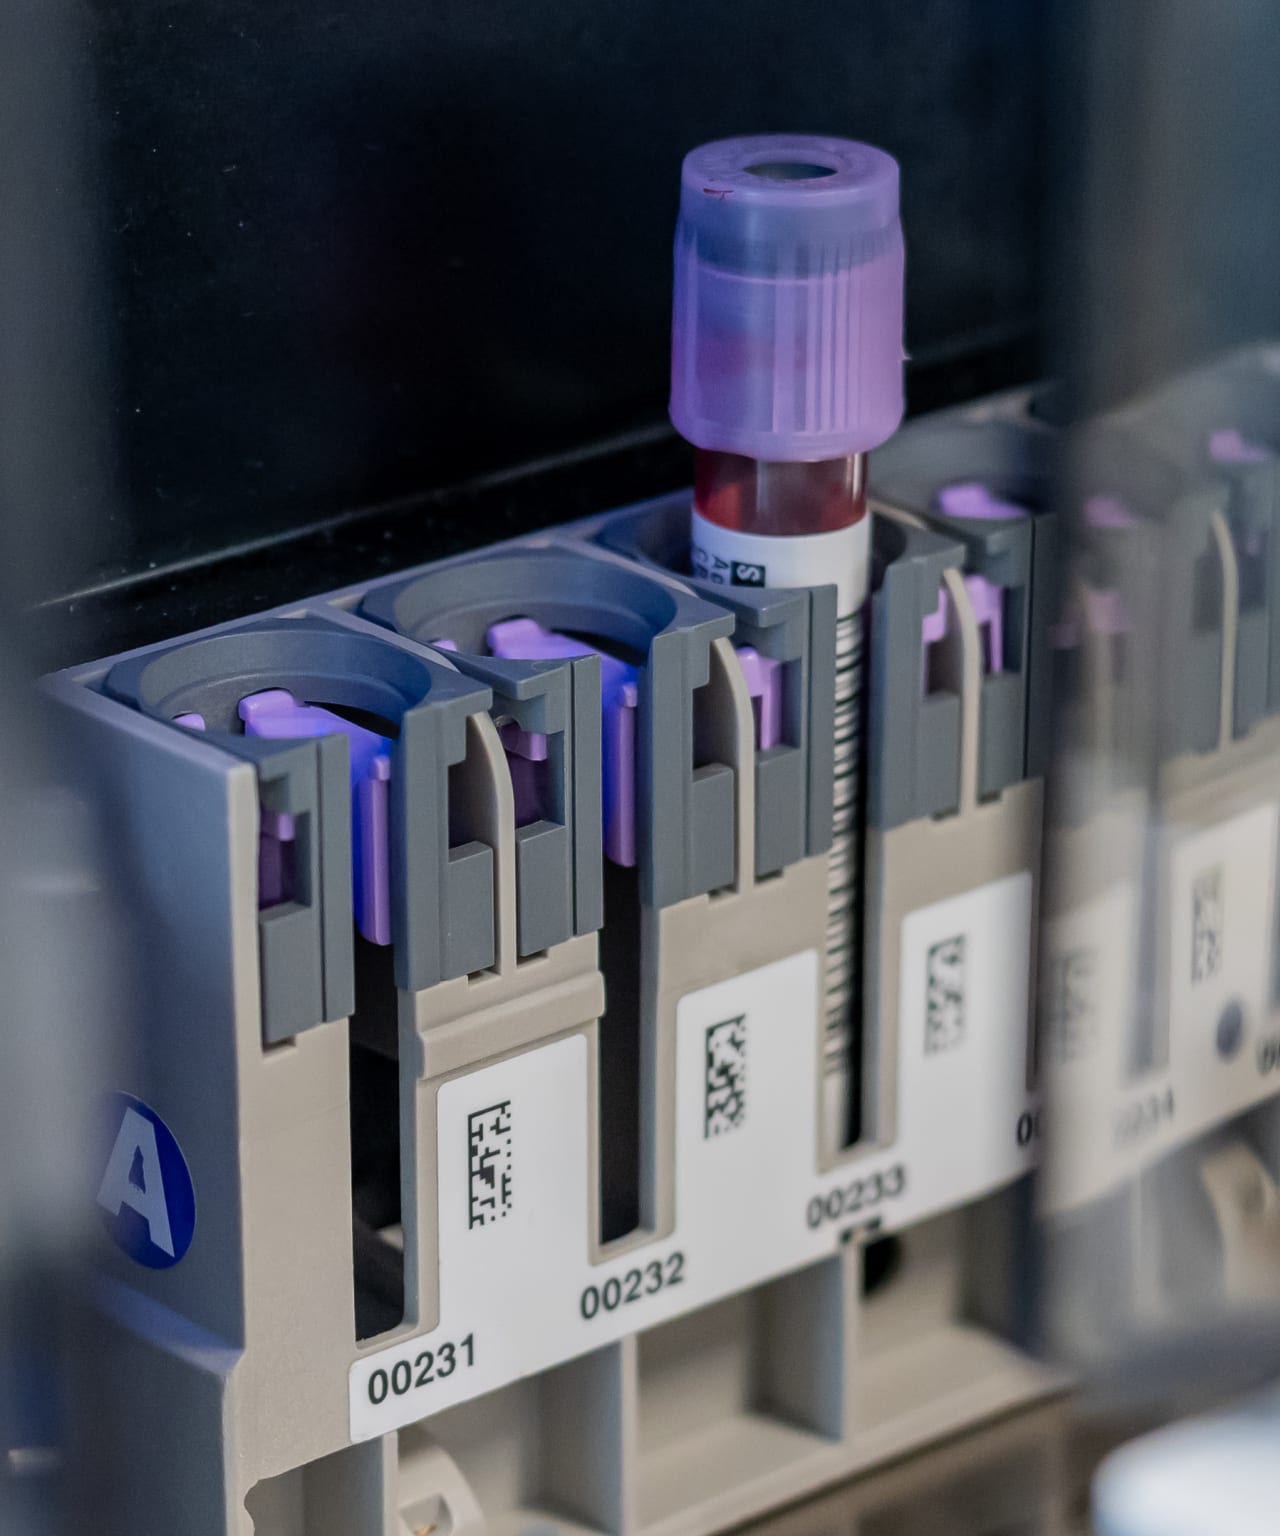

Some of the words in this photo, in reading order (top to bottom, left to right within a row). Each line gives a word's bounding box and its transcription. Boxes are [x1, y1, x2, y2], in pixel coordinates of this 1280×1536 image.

[96, 1106, 174, 1258] A
[806, 1163, 906, 1229] 00233
[579, 1251, 685, 1321] 00232
[367, 1332, 475, 1405] 00231
